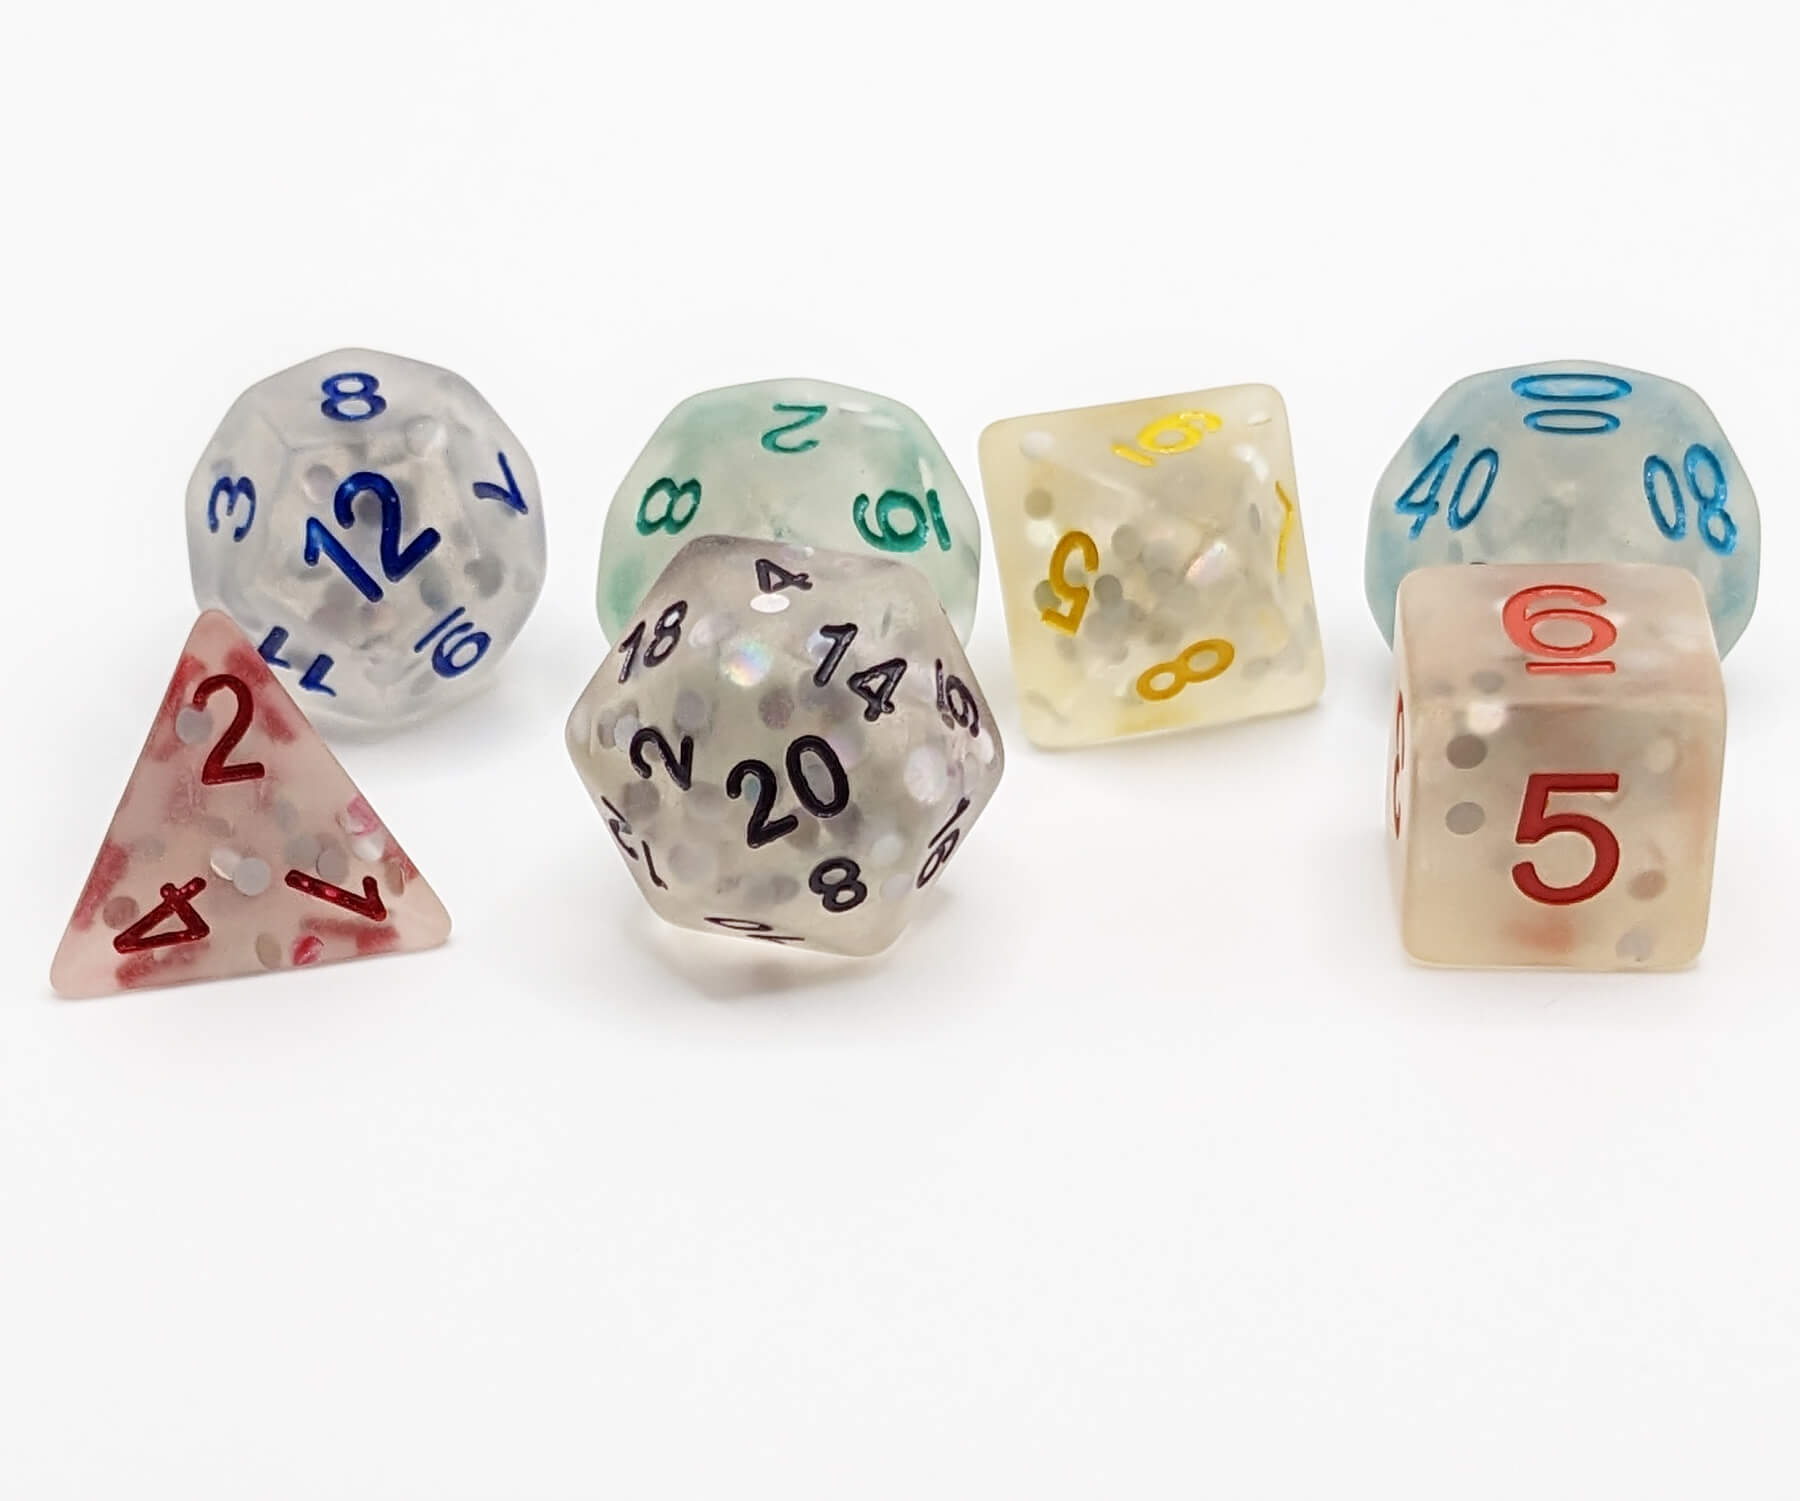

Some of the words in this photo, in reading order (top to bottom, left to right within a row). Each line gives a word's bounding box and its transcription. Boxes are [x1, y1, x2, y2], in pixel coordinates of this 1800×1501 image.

[321, 372, 386, 421] 8
[761, 403, 827, 453] 2
[1511, 373, 1632, 434] 00
[208, 476, 256, 542] 3
[636, 477, 701, 535] 8
[1395, 434, 1498, 540] 40
[1643, 443, 1738, 554] 80
[304, 471, 440, 602] 12
[756, 559, 813, 594] 4
[1040, 531, 1099, 637] 5
[618, 600, 688, 683] 18
[1502, 585, 1617, 674] 6
[813, 623, 907, 722] 14
[1136, 638, 1235, 701] 8
[193, 674, 265, 785] 2
[630, 727, 693, 791] 2
[726, 735, 850, 848] 20
[1511, 773, 1620, 906] 5
[113, 877, 210, 954] 4
[285, 870, 387, 922] 1
[809, 857, 867, 913] 8
